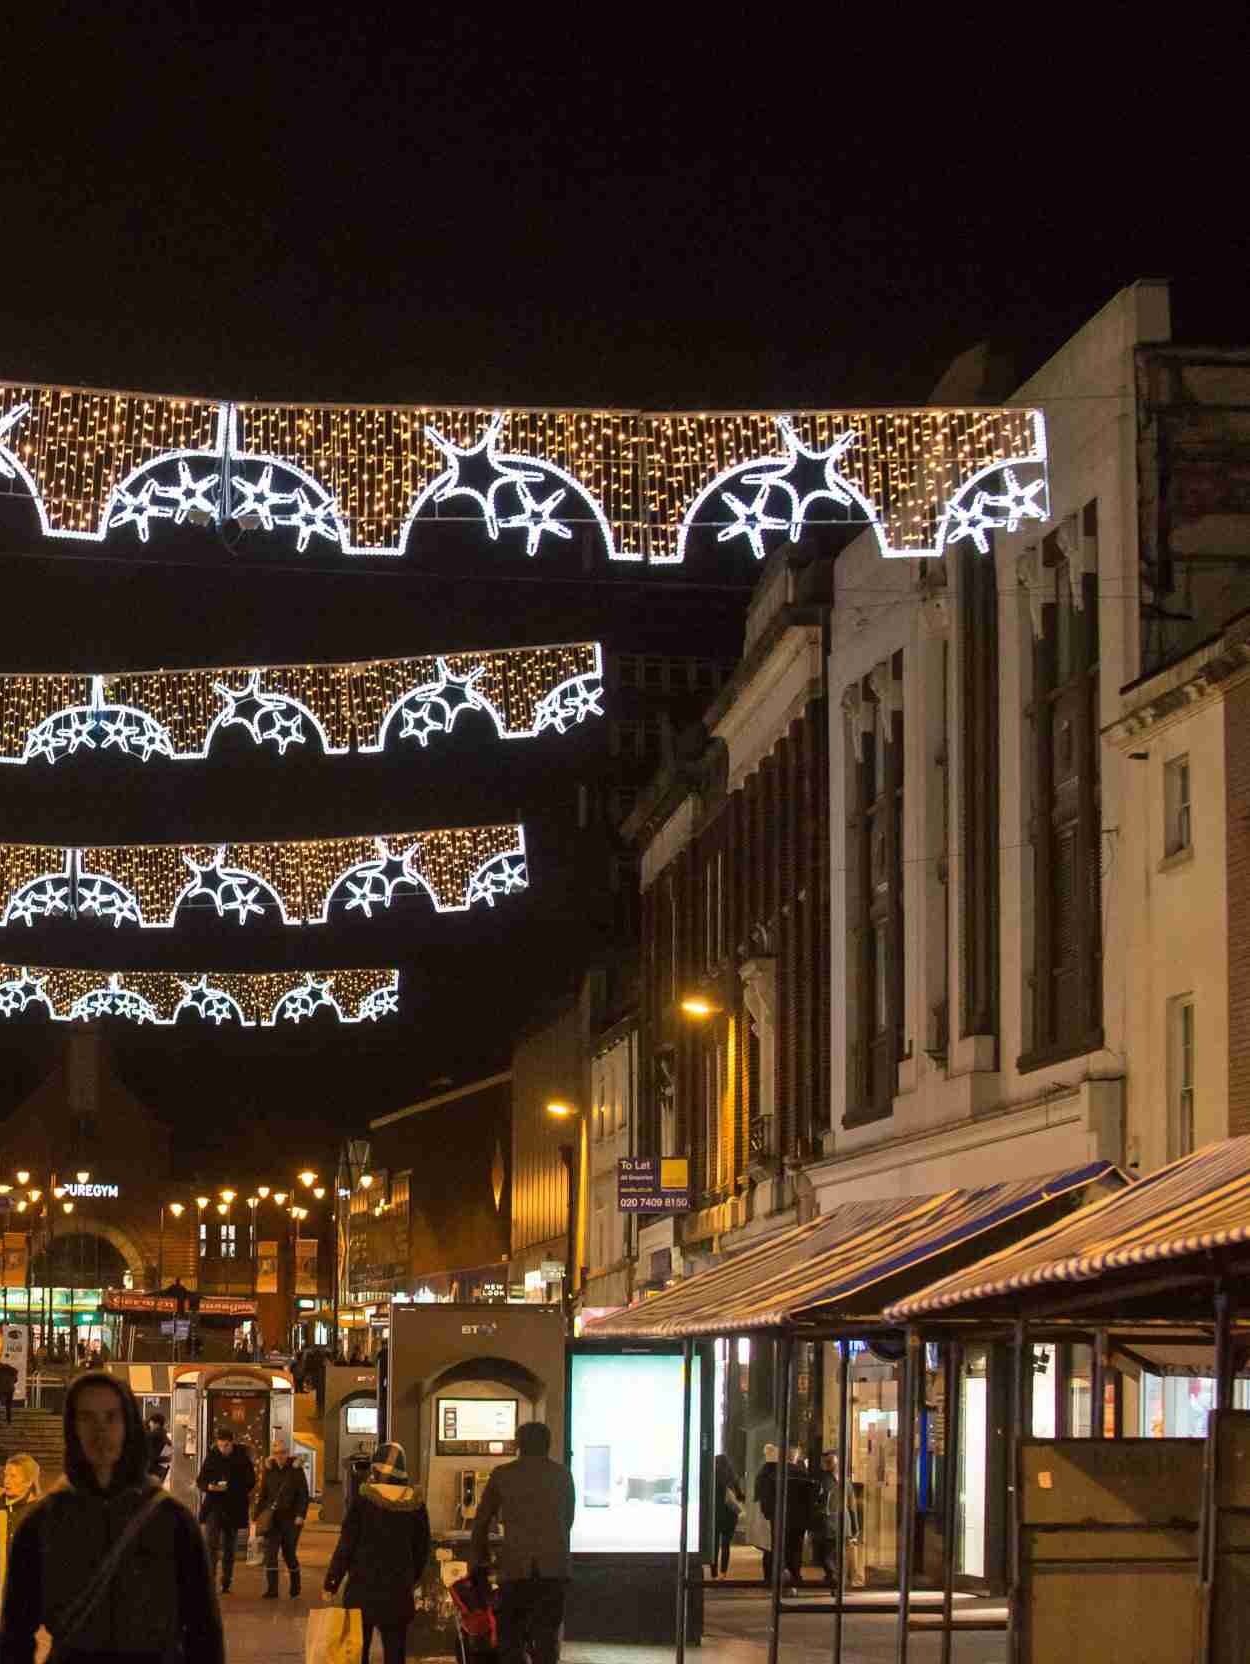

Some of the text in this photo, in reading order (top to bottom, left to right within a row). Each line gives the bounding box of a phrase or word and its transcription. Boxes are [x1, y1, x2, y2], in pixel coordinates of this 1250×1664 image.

[620, 1160, 652, 1170] To Let
[62, 1183, 119, 1198] PUREGYM
[620, 1198, 638, 1208] 020
